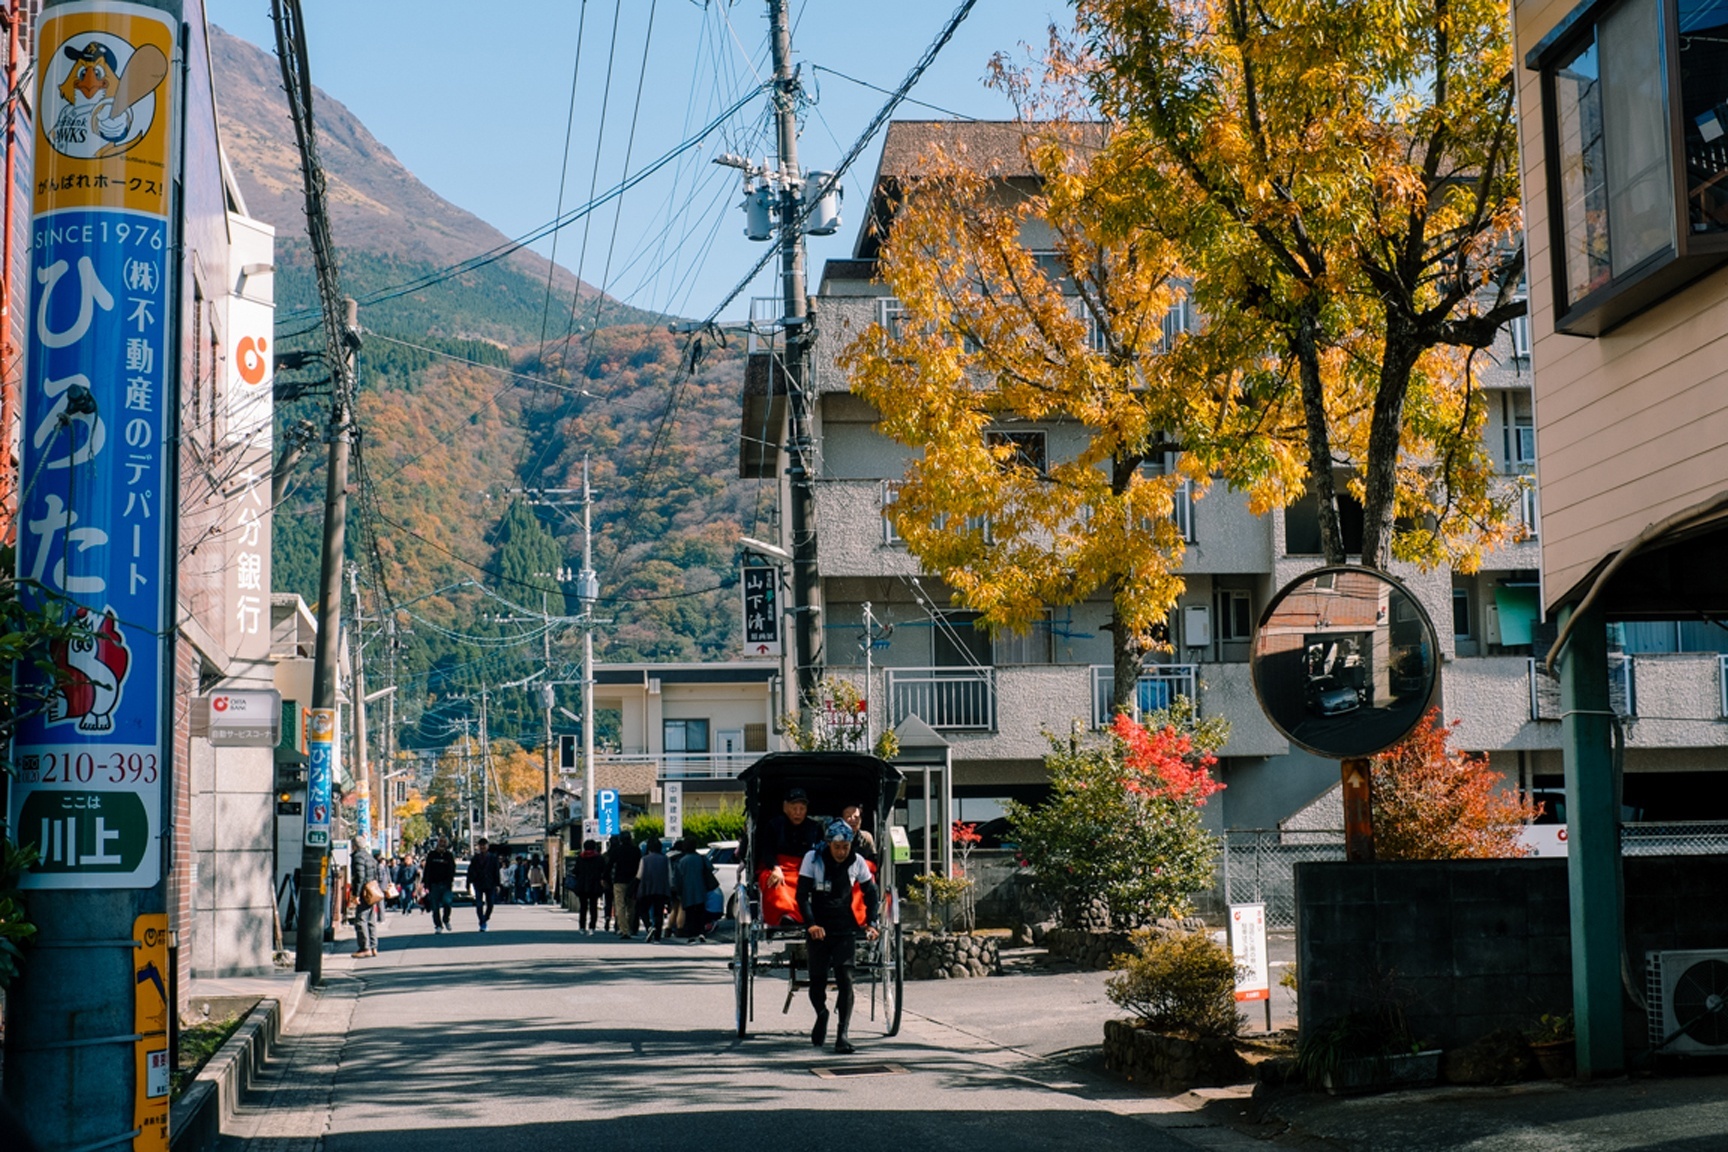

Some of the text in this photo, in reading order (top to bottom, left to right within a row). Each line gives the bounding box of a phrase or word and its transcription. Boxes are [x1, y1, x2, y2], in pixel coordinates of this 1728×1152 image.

[37, 173, 163, 195] がんばれホークス!
[35, 221, 163, 250] SINCE 1976
[28, 256, 114, 596] ひろた
[236, 467, 262, 634] 大分銀行
[746, 574, 766, 631] 山下清
[42, 752, 158, 784] 210-393
[310, 749, 326, 801] ひろた
[61, 795, 102, 809] ここは
[601, 790, 615, 810] P
[40, 816, 122, 867] 川上
